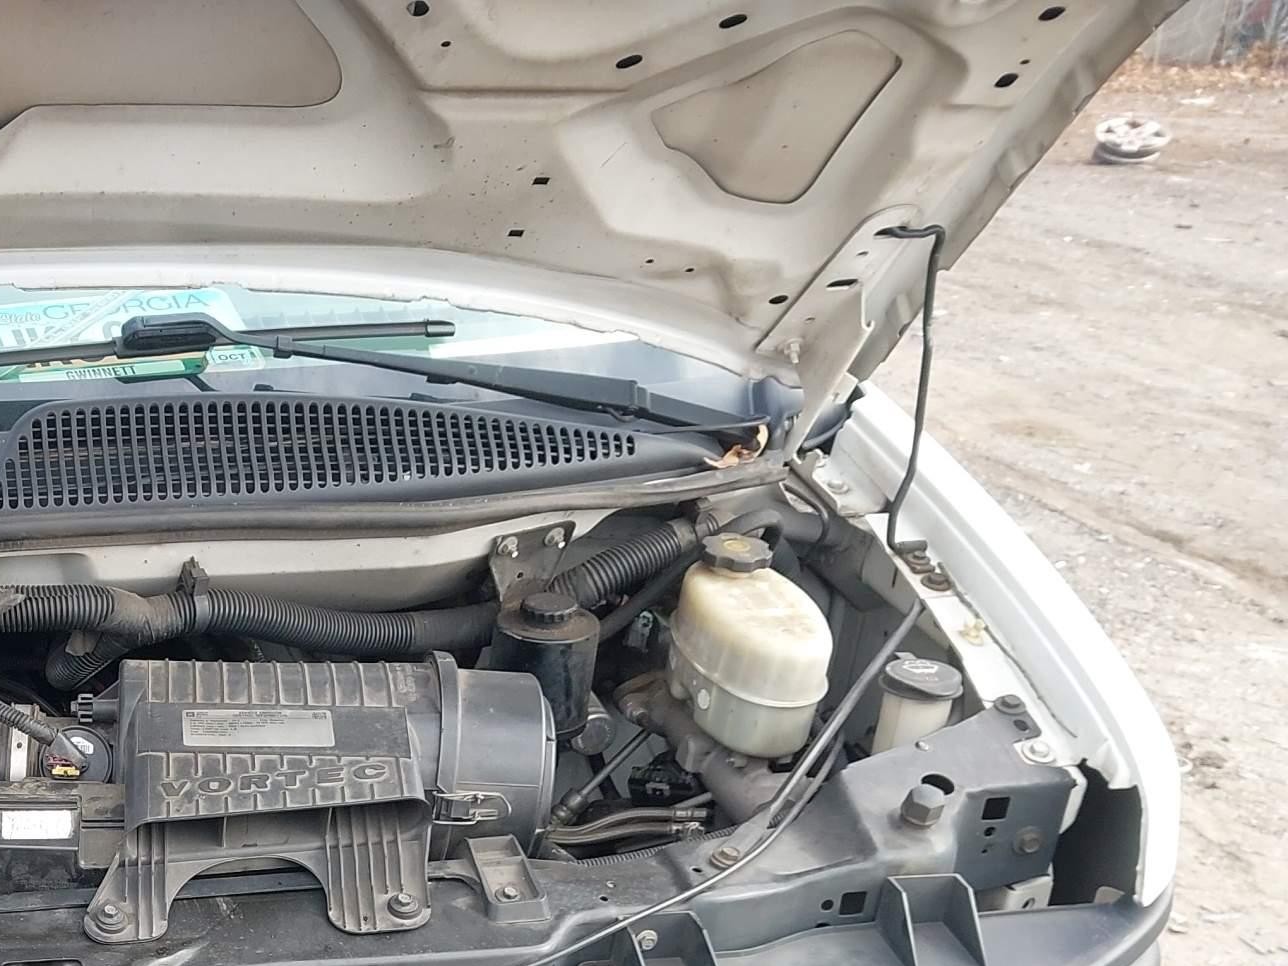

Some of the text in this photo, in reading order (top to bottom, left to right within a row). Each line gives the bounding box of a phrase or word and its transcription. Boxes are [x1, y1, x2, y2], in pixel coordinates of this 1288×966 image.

[217, 353, 246, 362] OCT
[66, 365, 137, 381] GWINNETT
[160, 762, 388, 798] VORTEC
